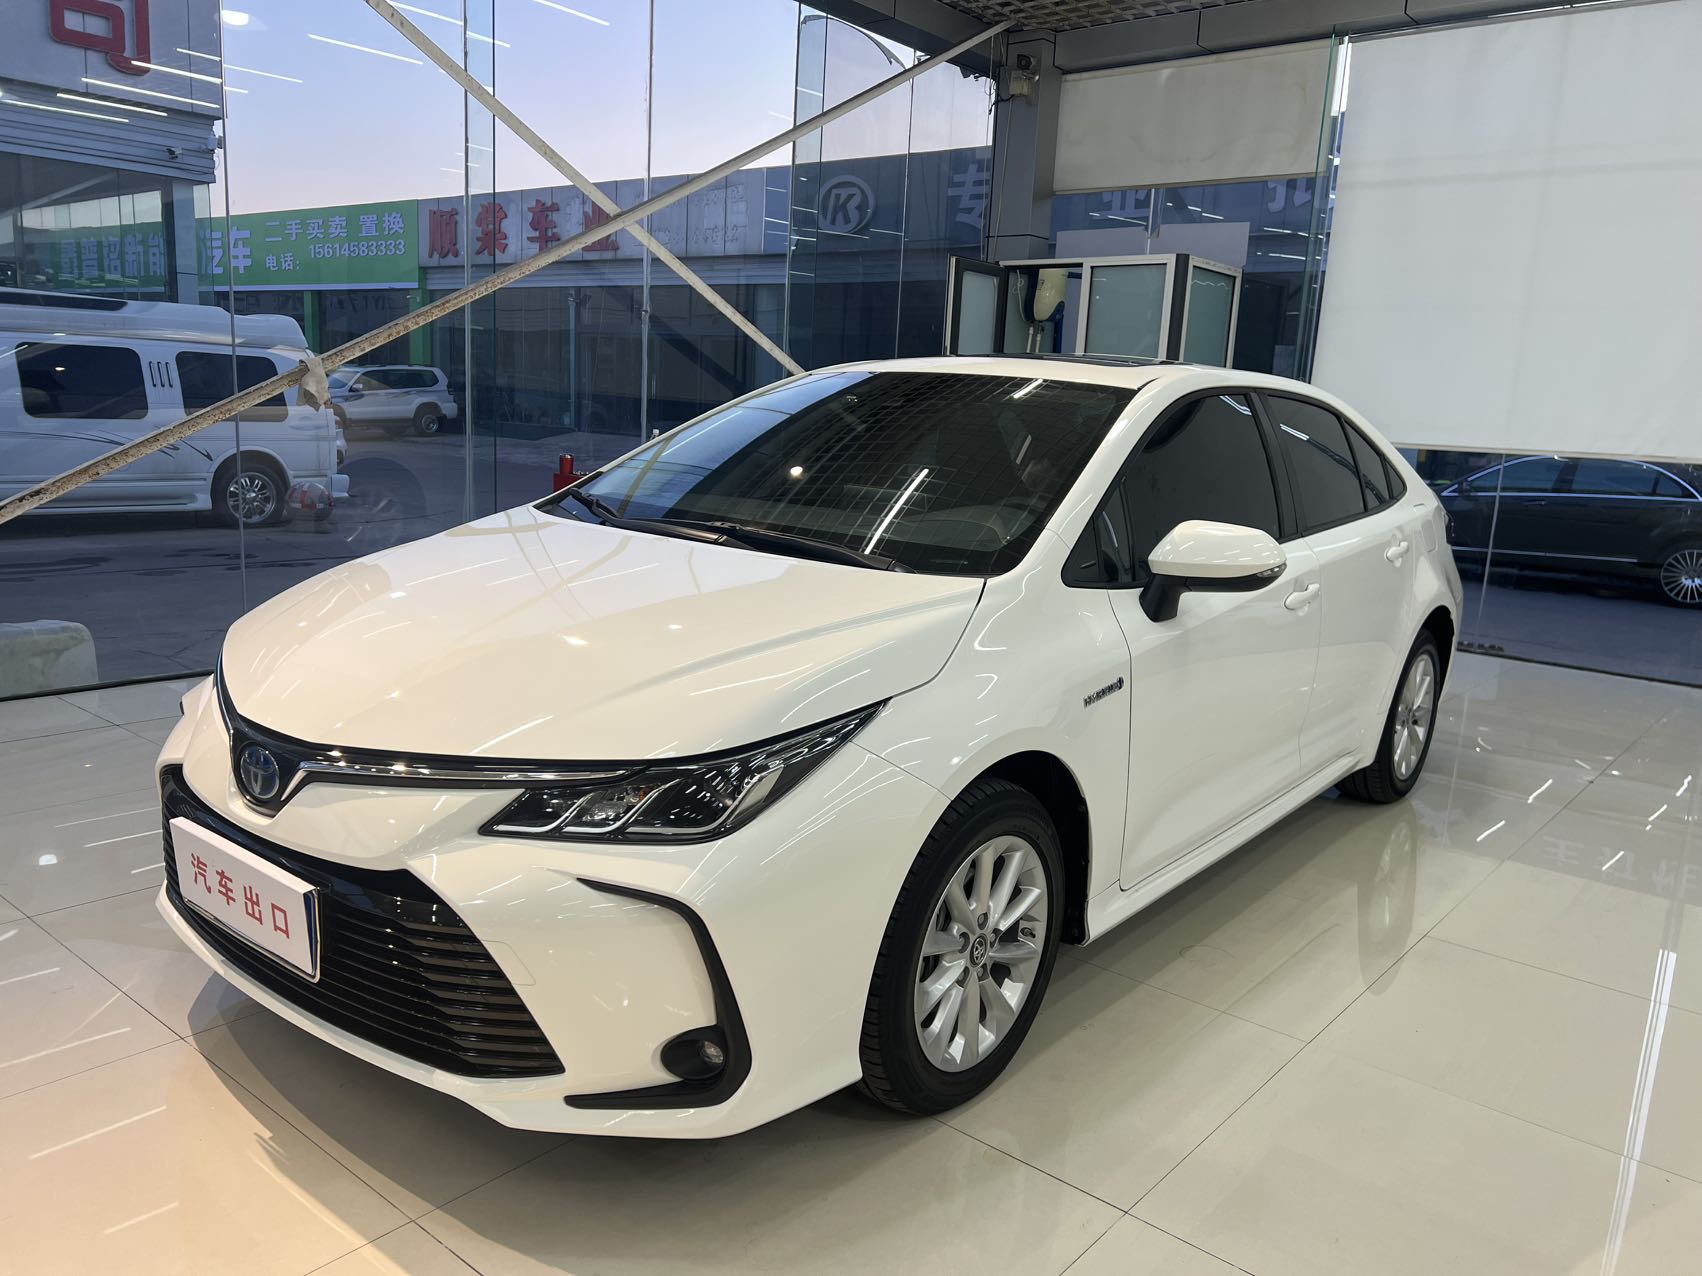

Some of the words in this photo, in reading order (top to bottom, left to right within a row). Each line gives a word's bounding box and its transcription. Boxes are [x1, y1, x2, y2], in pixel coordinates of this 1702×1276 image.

[264, 215, 348, 242] 二手买卖
[358, 211, 404, 238] 置换
[308, 239, 405, 259] 15614583333
[190, 852, 290, 939] 汽车出口
